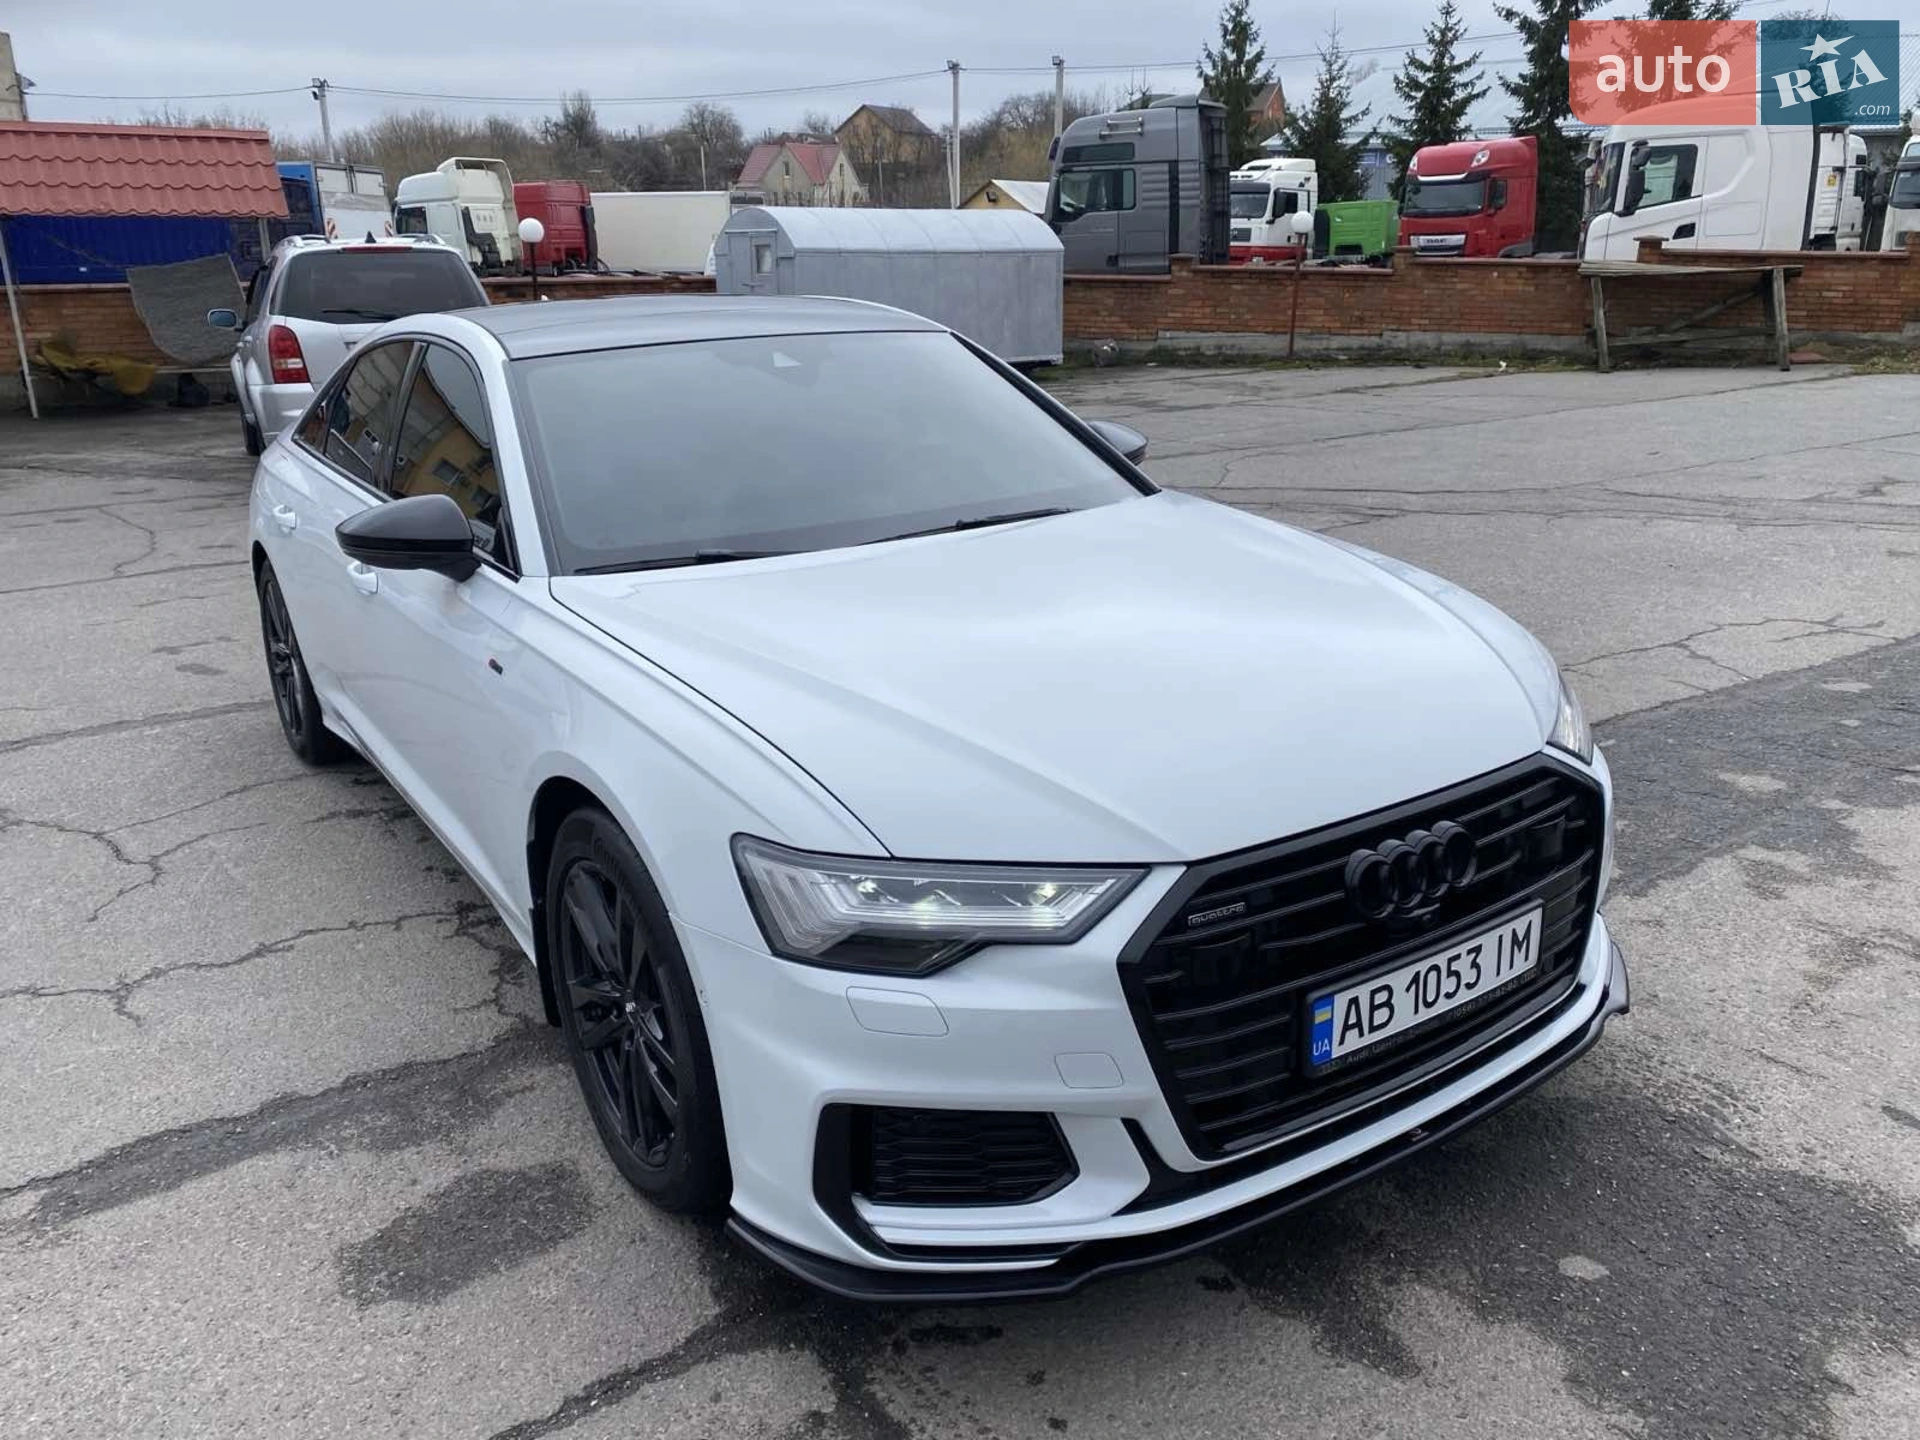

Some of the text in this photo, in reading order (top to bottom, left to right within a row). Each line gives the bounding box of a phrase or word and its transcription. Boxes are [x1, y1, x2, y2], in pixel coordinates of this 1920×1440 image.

[1191, 905, 1244, 925] quattro
[1338, 983, 1395, 1047] AB
[1404, 944, 1483, 1015] 1053
[1495, 920, 1533, 977] IM
[1313, 1036, 1331, 1056] UA
